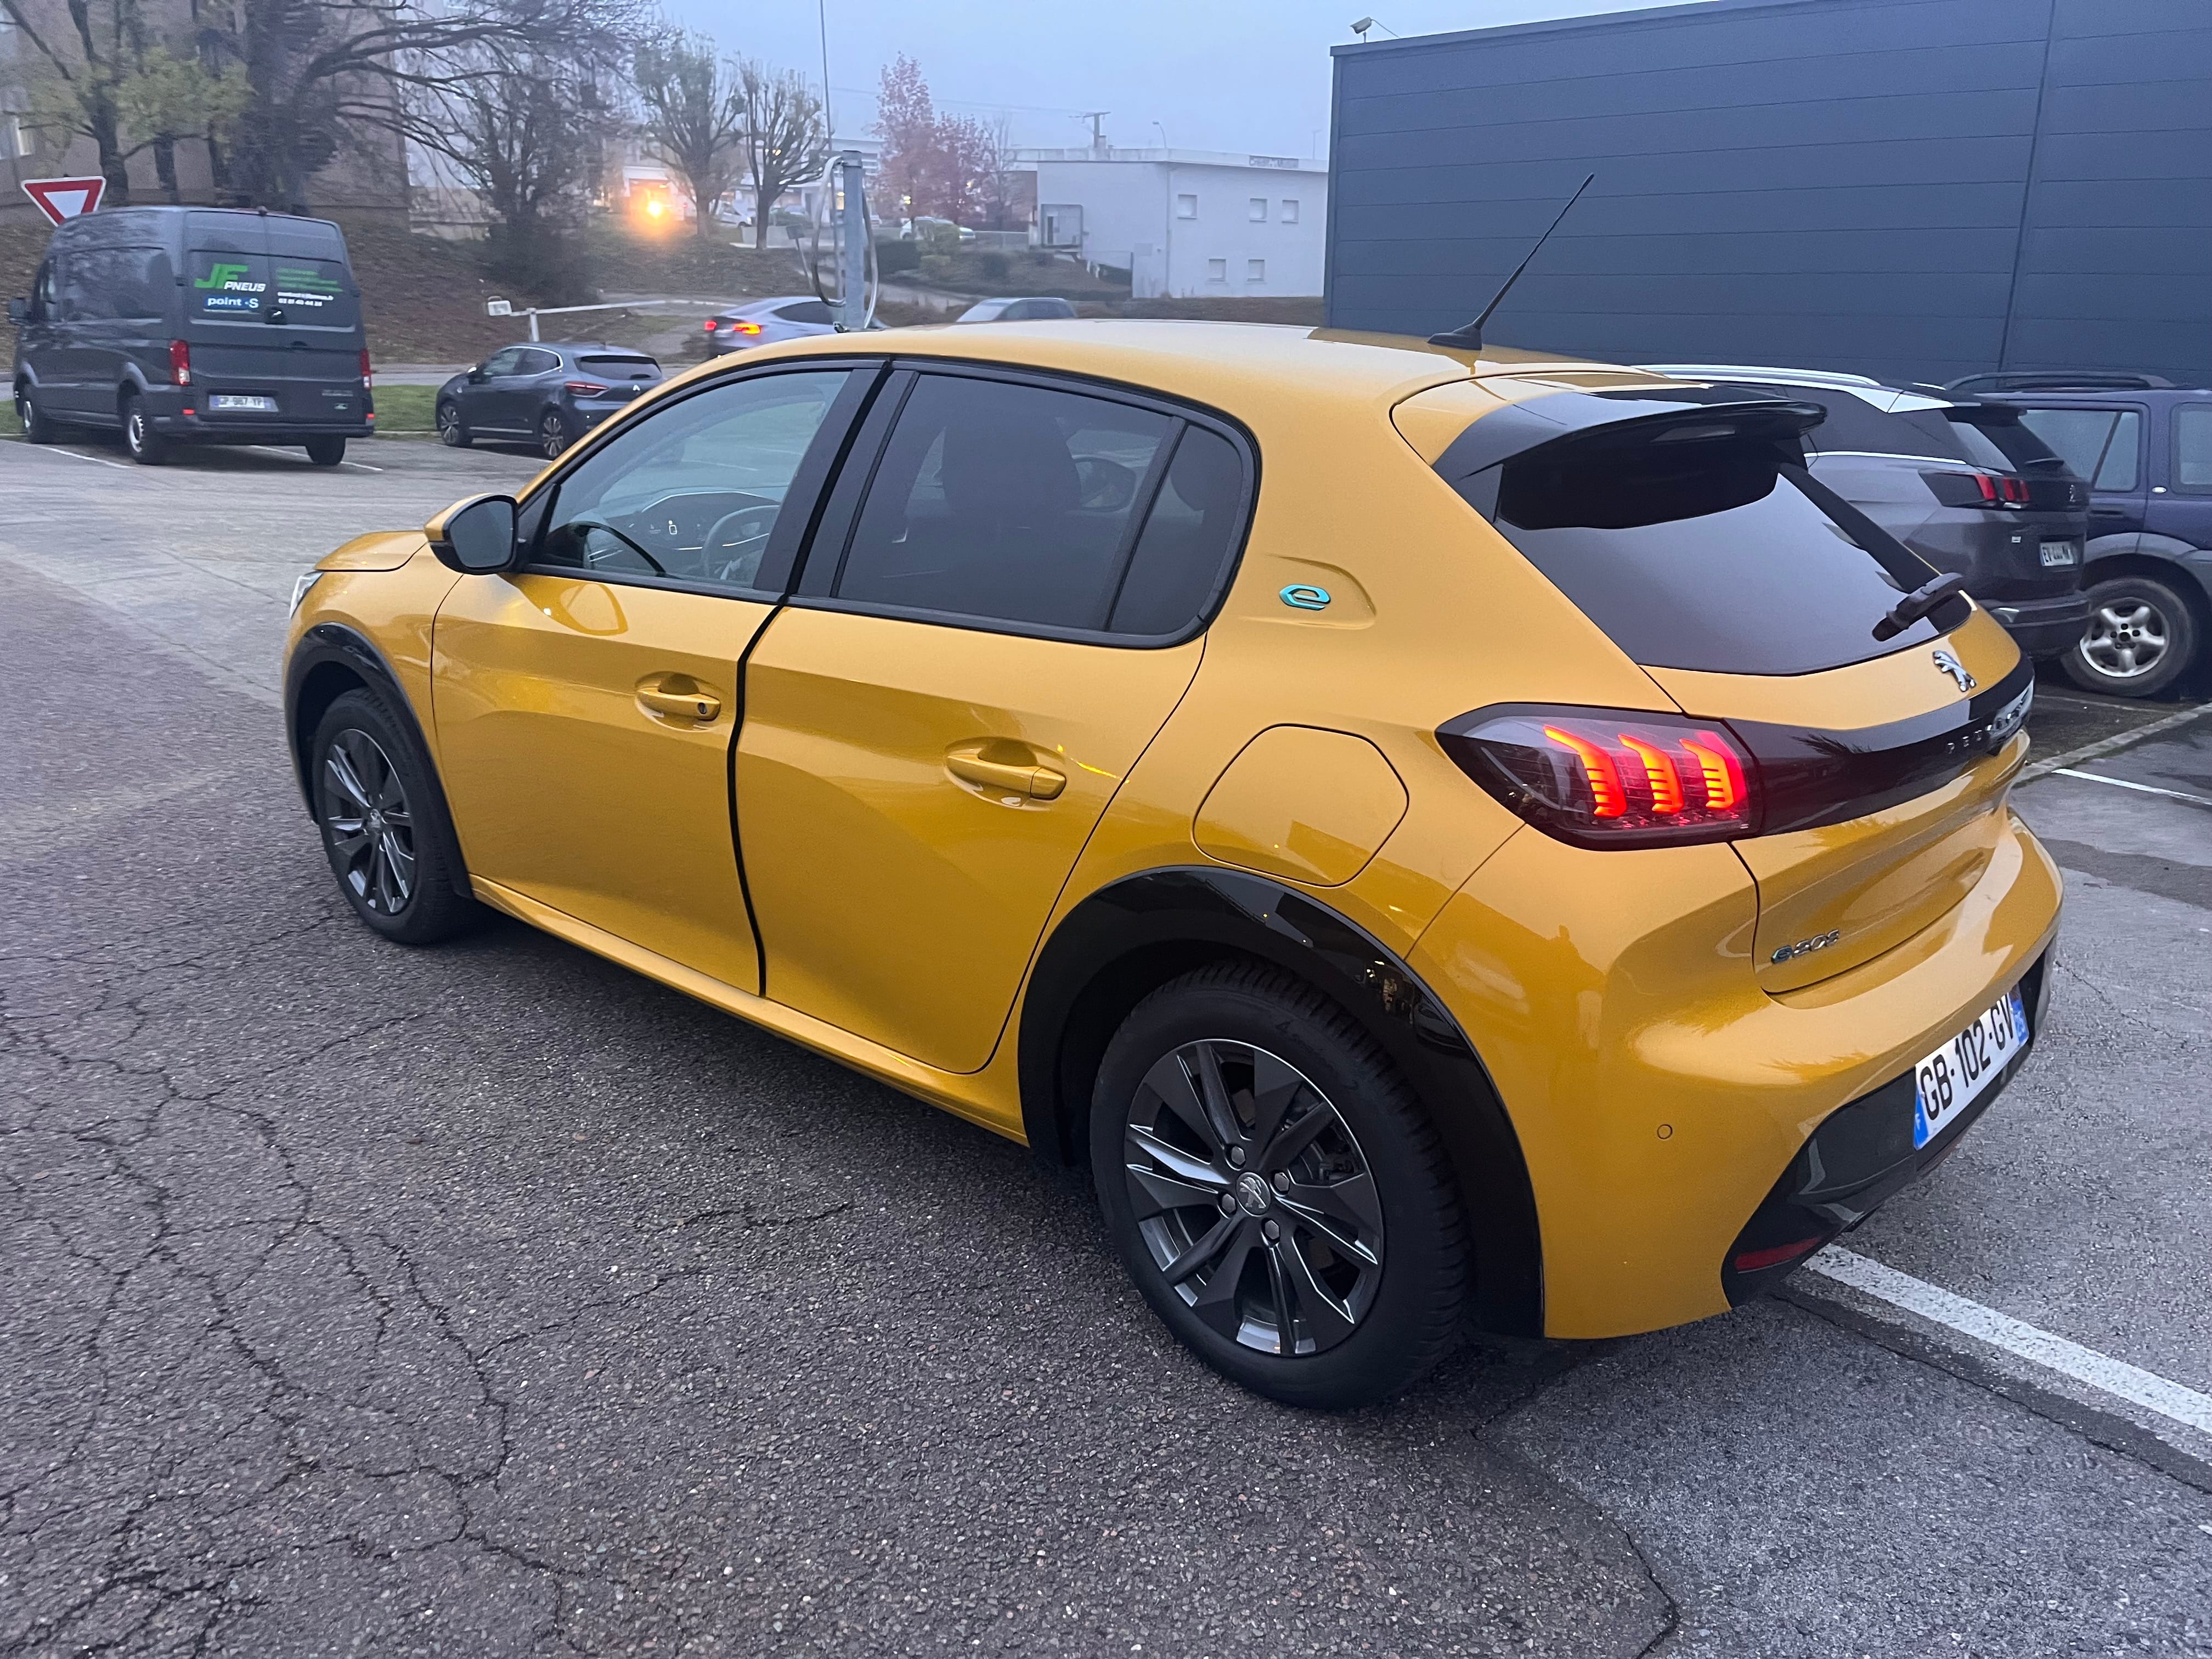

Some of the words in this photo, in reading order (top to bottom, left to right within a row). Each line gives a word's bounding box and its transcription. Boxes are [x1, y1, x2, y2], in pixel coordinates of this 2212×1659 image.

[194, 263, 249, 289] JF
[224, 281, 266, 292] PNEUS
[207, 297, 242, 306] point
